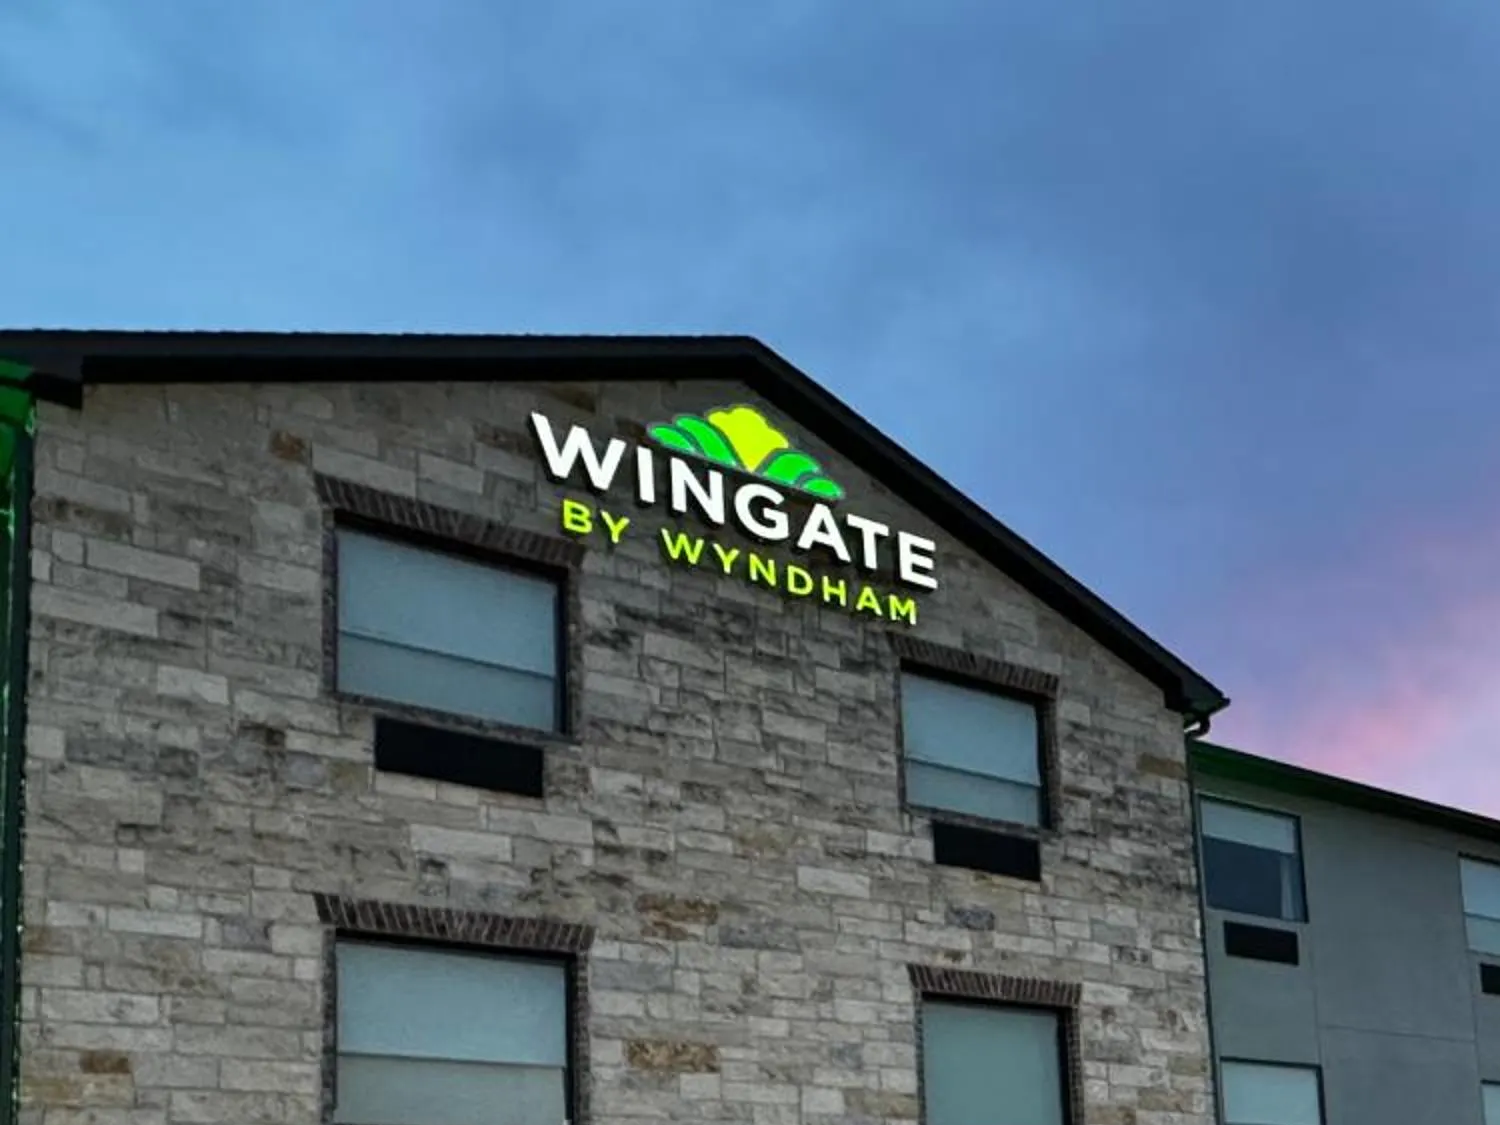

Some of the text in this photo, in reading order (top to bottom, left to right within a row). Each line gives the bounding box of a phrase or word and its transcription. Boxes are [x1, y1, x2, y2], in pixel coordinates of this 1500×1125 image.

[530, 411, 938, 590] WINGATE
[562, 499, 918, 626] BY WYNDHAM
